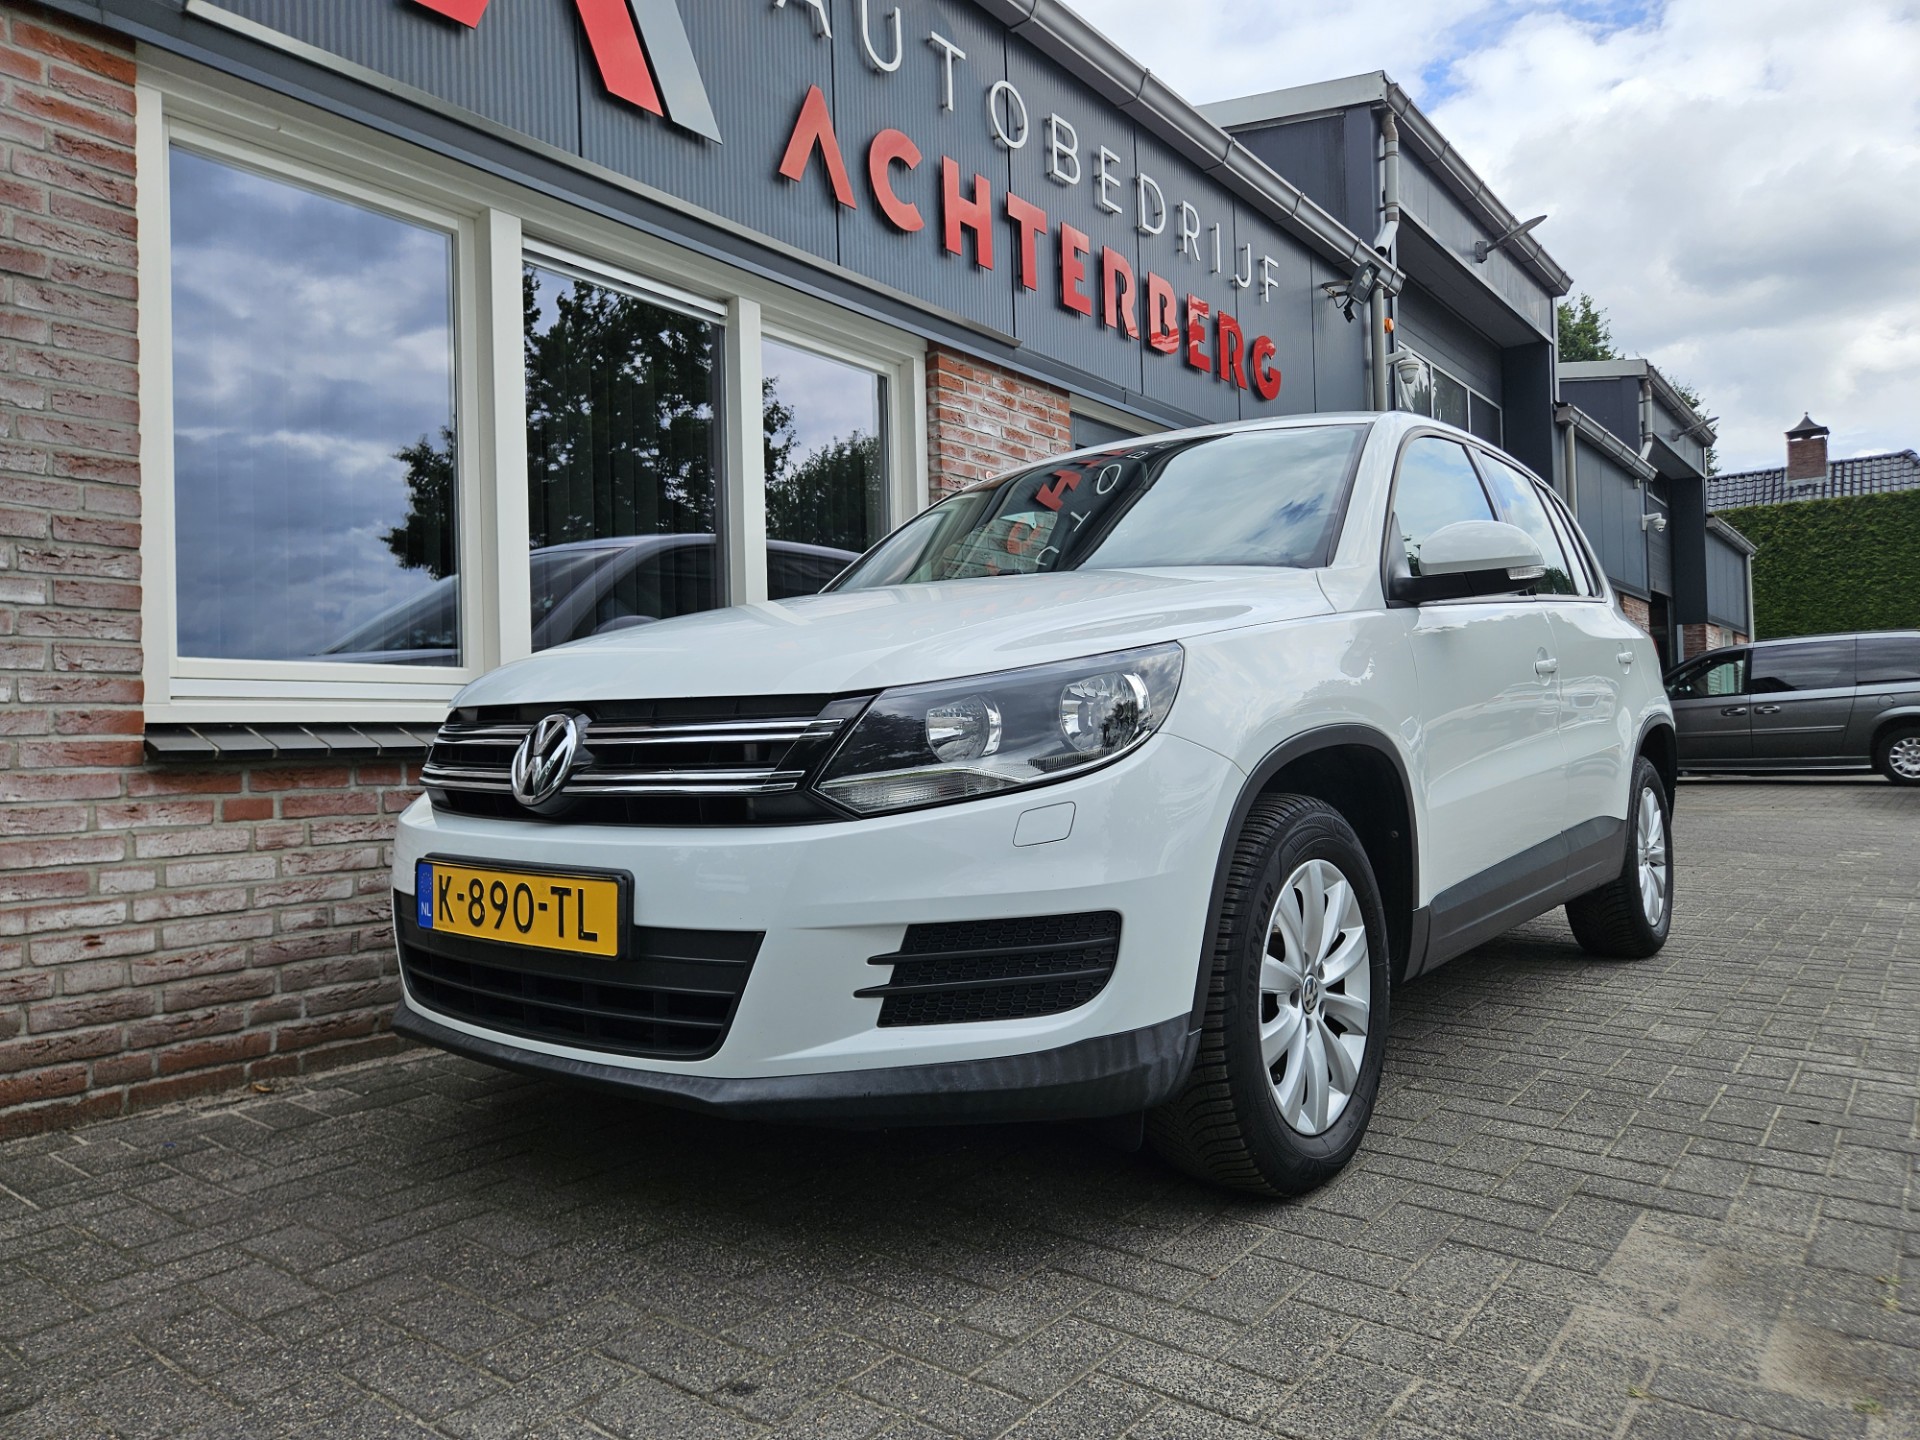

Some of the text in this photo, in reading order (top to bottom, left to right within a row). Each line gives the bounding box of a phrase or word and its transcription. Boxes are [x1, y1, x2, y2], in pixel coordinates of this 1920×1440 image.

[778, 84, 1282, 401] ACHTERBERG
[420, 901, 431, 917] NL
[438, 874, 598, 942] K-890-TL
